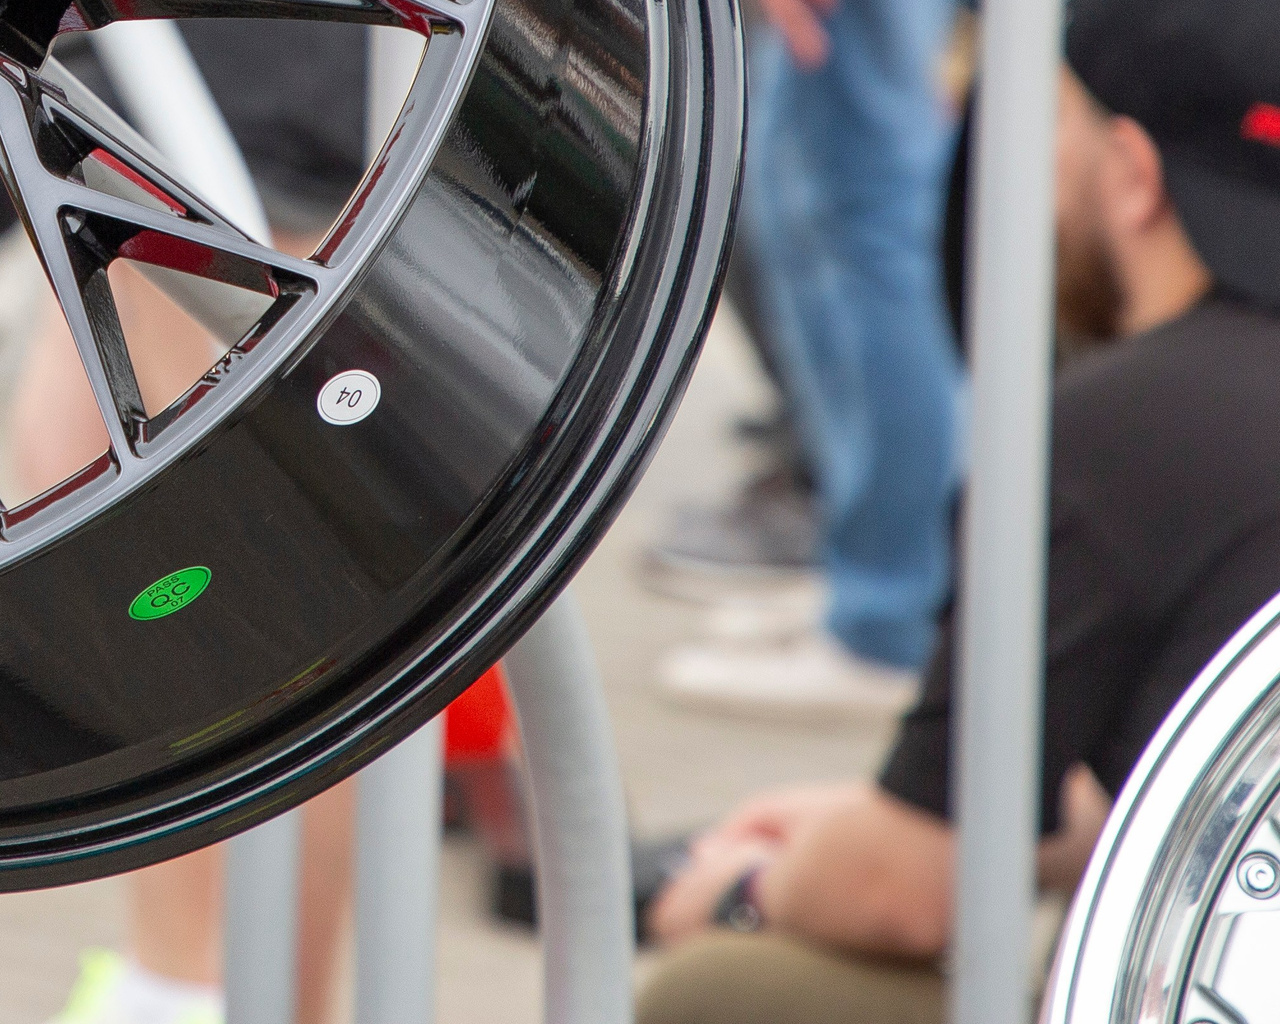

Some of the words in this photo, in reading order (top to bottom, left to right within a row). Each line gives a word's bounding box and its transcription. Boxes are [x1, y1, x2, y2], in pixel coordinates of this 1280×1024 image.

[335, 386, 362, 408] 04
[146, 575, 180, 597] PASS
[150, 581, 191, 608] QC
[170, 596, 185, 607] 07
